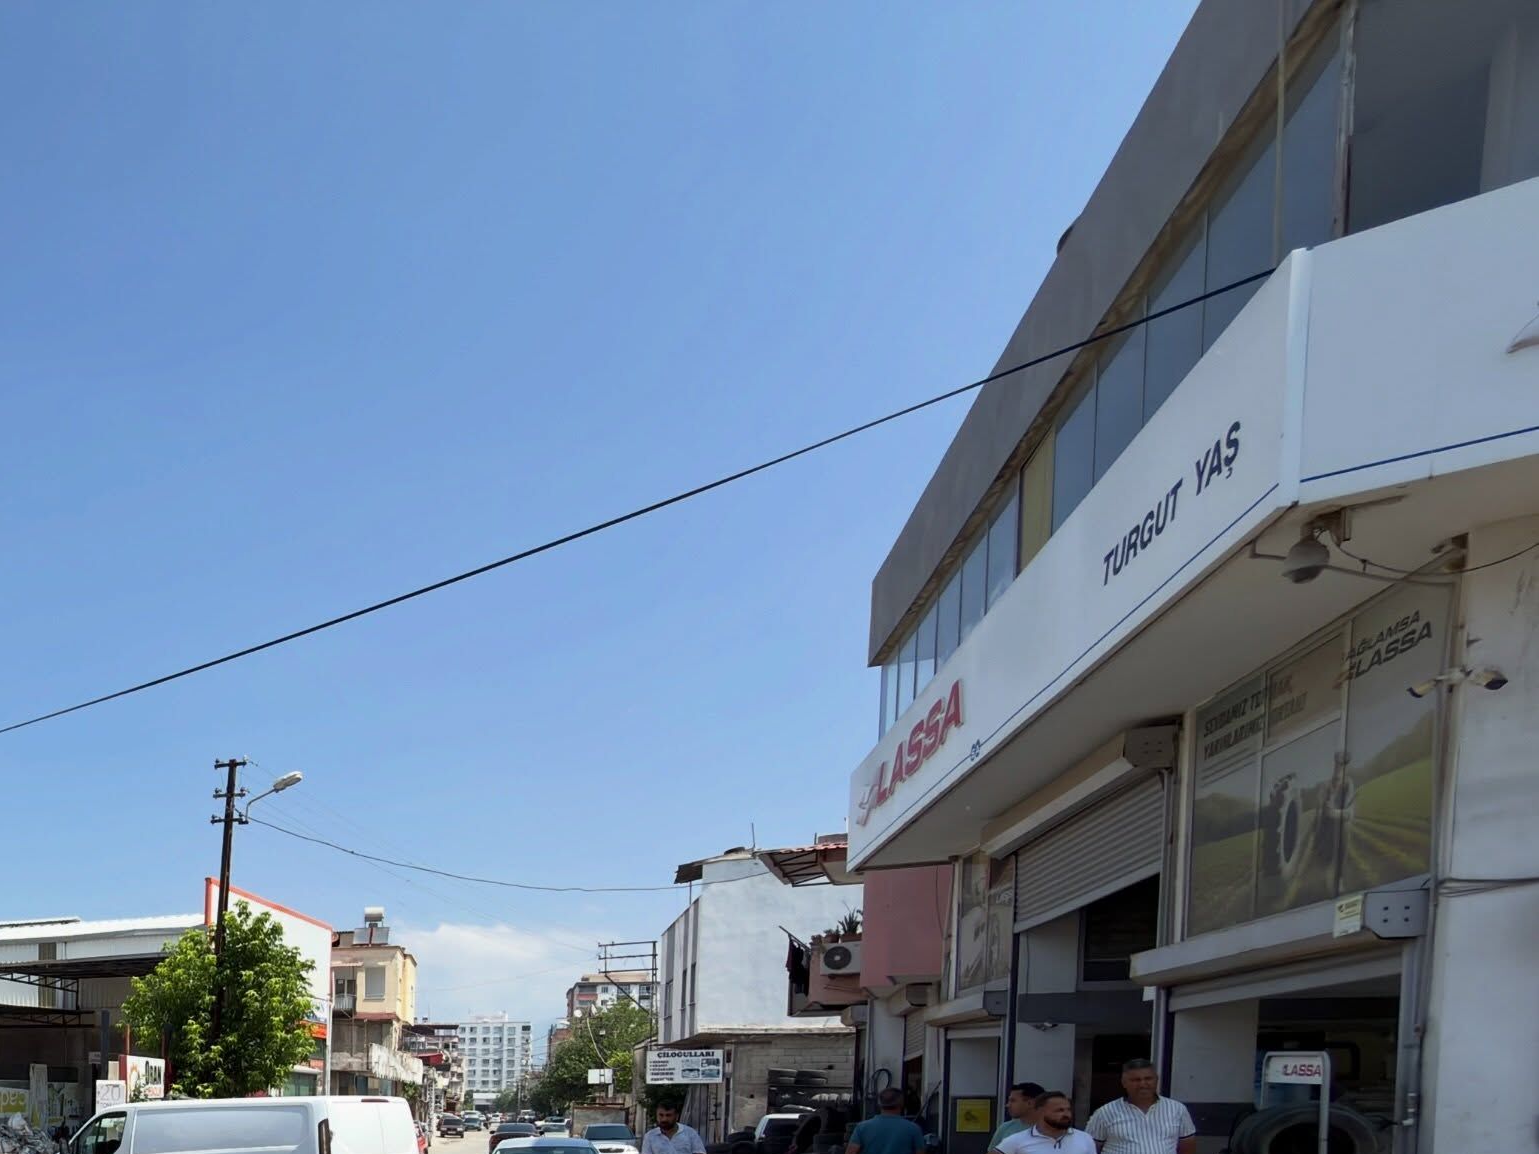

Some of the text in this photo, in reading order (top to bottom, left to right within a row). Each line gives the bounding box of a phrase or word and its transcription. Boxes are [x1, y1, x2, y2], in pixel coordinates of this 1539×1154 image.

[1103, 420, 1241, 587] TURGUT YAŞ
[1353, 620, 1433, 680] LASSA
[875, 679, 963, 808] LASSA
[1282, 1063, 1322, 1077] LASSA
